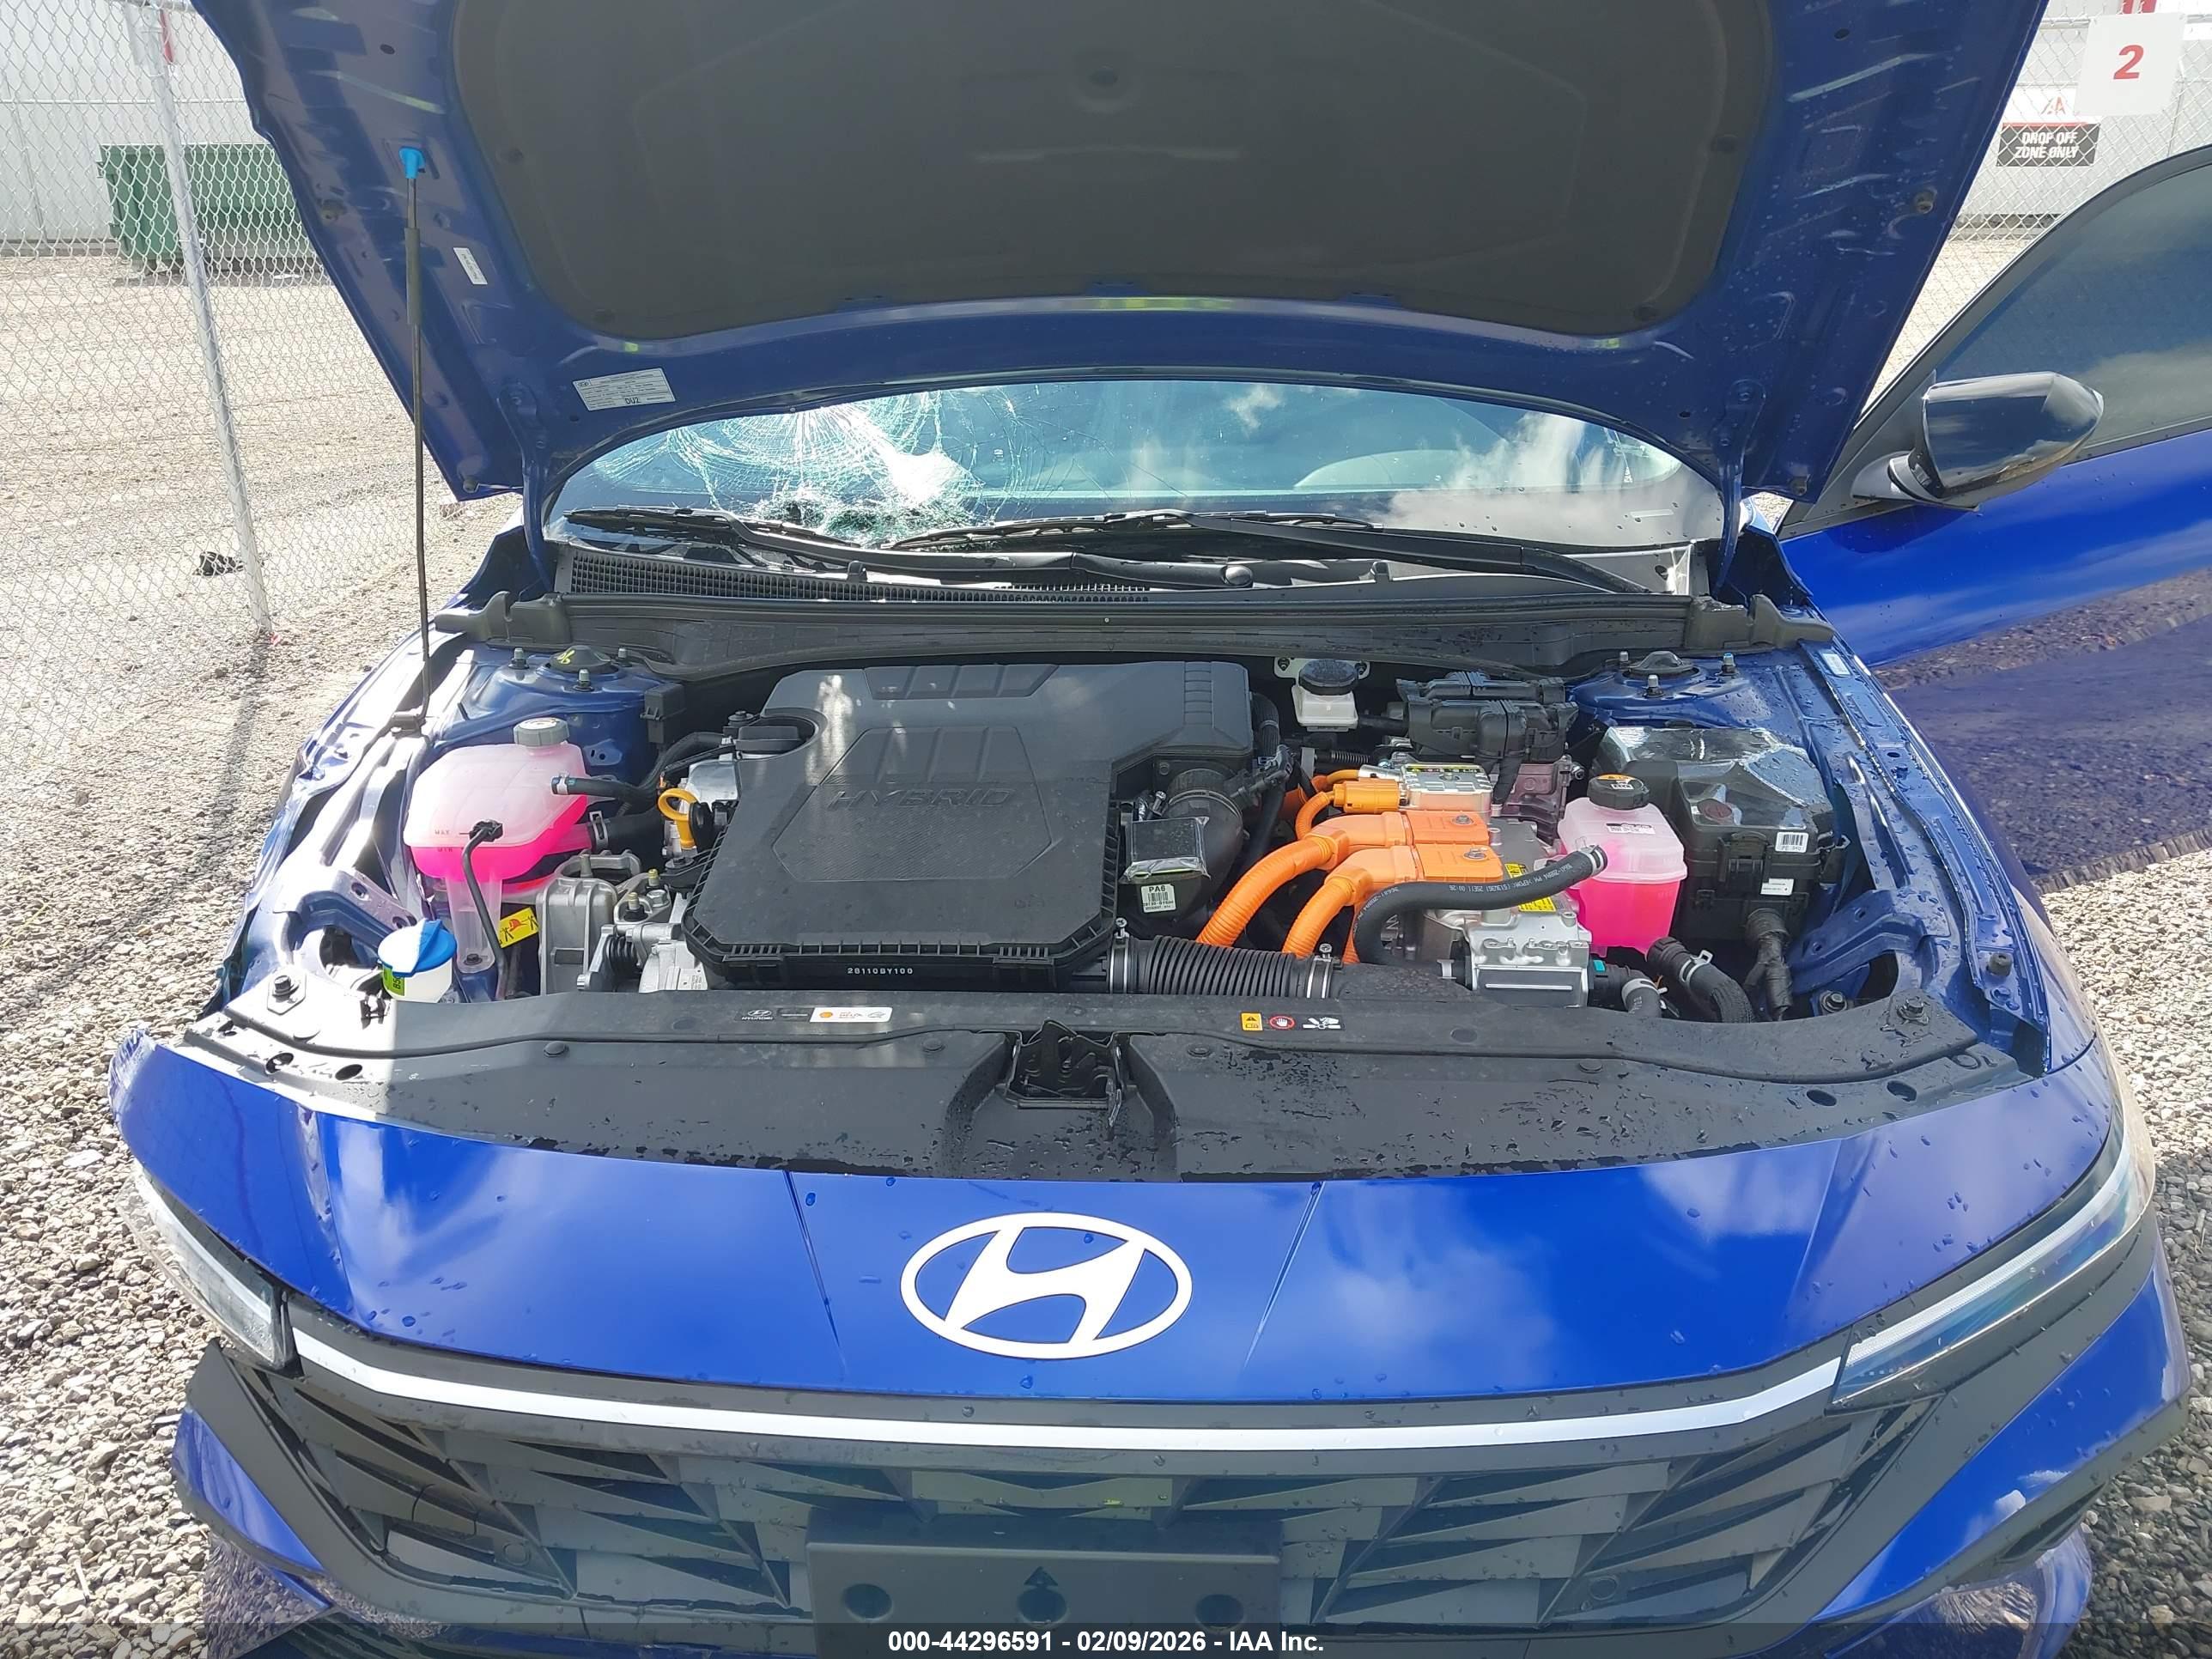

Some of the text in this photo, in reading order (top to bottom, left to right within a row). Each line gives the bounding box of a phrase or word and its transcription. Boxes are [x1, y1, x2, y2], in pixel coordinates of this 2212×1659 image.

[2113, 44, 2145, 81] 2
[2021, 131, 2079, 145] DROP OFF
[2014, 145, 2080, 159] ZONE ONLY
[624, 397, 641, 405] DU2
[827, 787, 1017, 811] HYBRID
